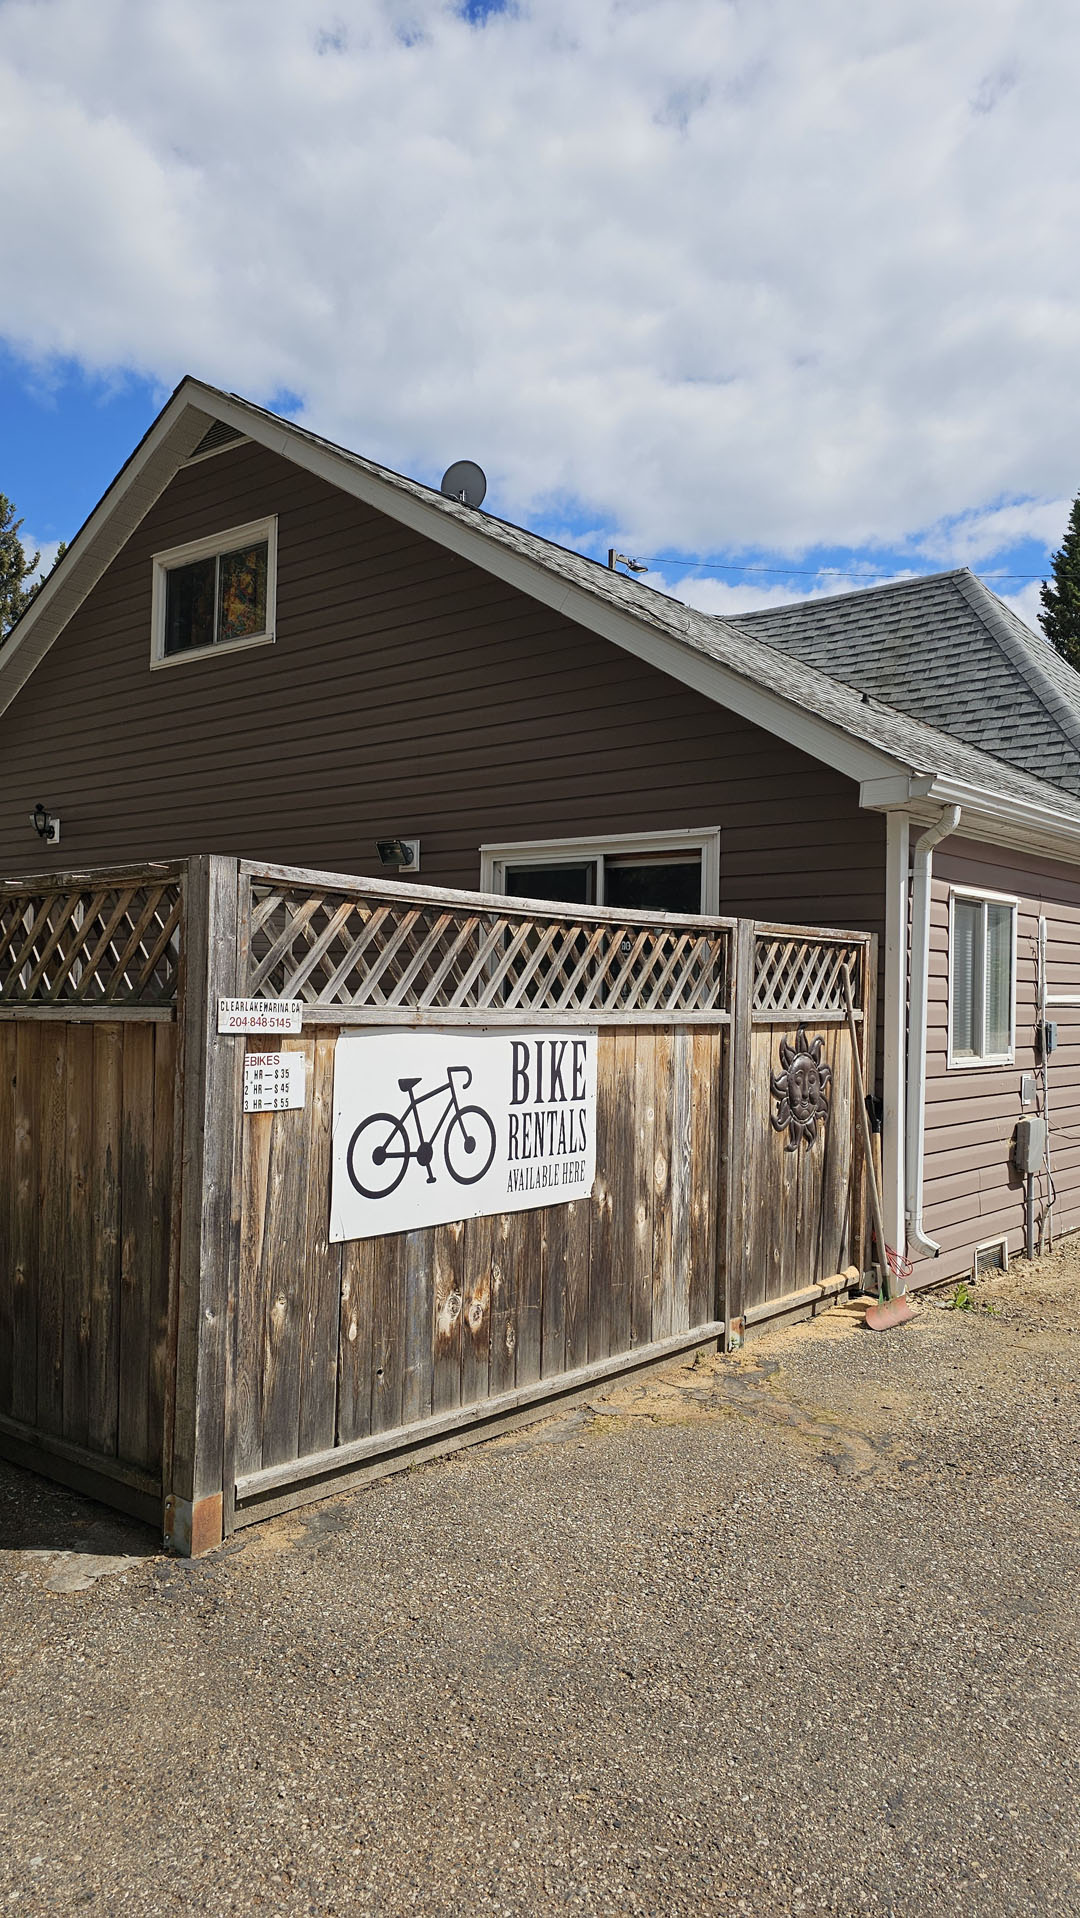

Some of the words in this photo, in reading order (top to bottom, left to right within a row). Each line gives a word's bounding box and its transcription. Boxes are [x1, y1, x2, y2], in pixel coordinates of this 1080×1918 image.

[244, 1055, 280, 1066] EBIKES
[245, 1071, 249, 1080] 1
[254, 1069, 263, 1080] HR
[509, 1040, 587, 1105] BIKE
[244, 1085, 249, 1095] 2
[253, 1084, 263, 1095] HR
[244, 1100, 249, 1110] 3
[253, 1099, 263, 1109] HR
[507, 1108, 587, 1161] RENTALS
[506, 1163, 559, 1193] AVAILABLE
[561, 1160, 586, 1185] HERE
